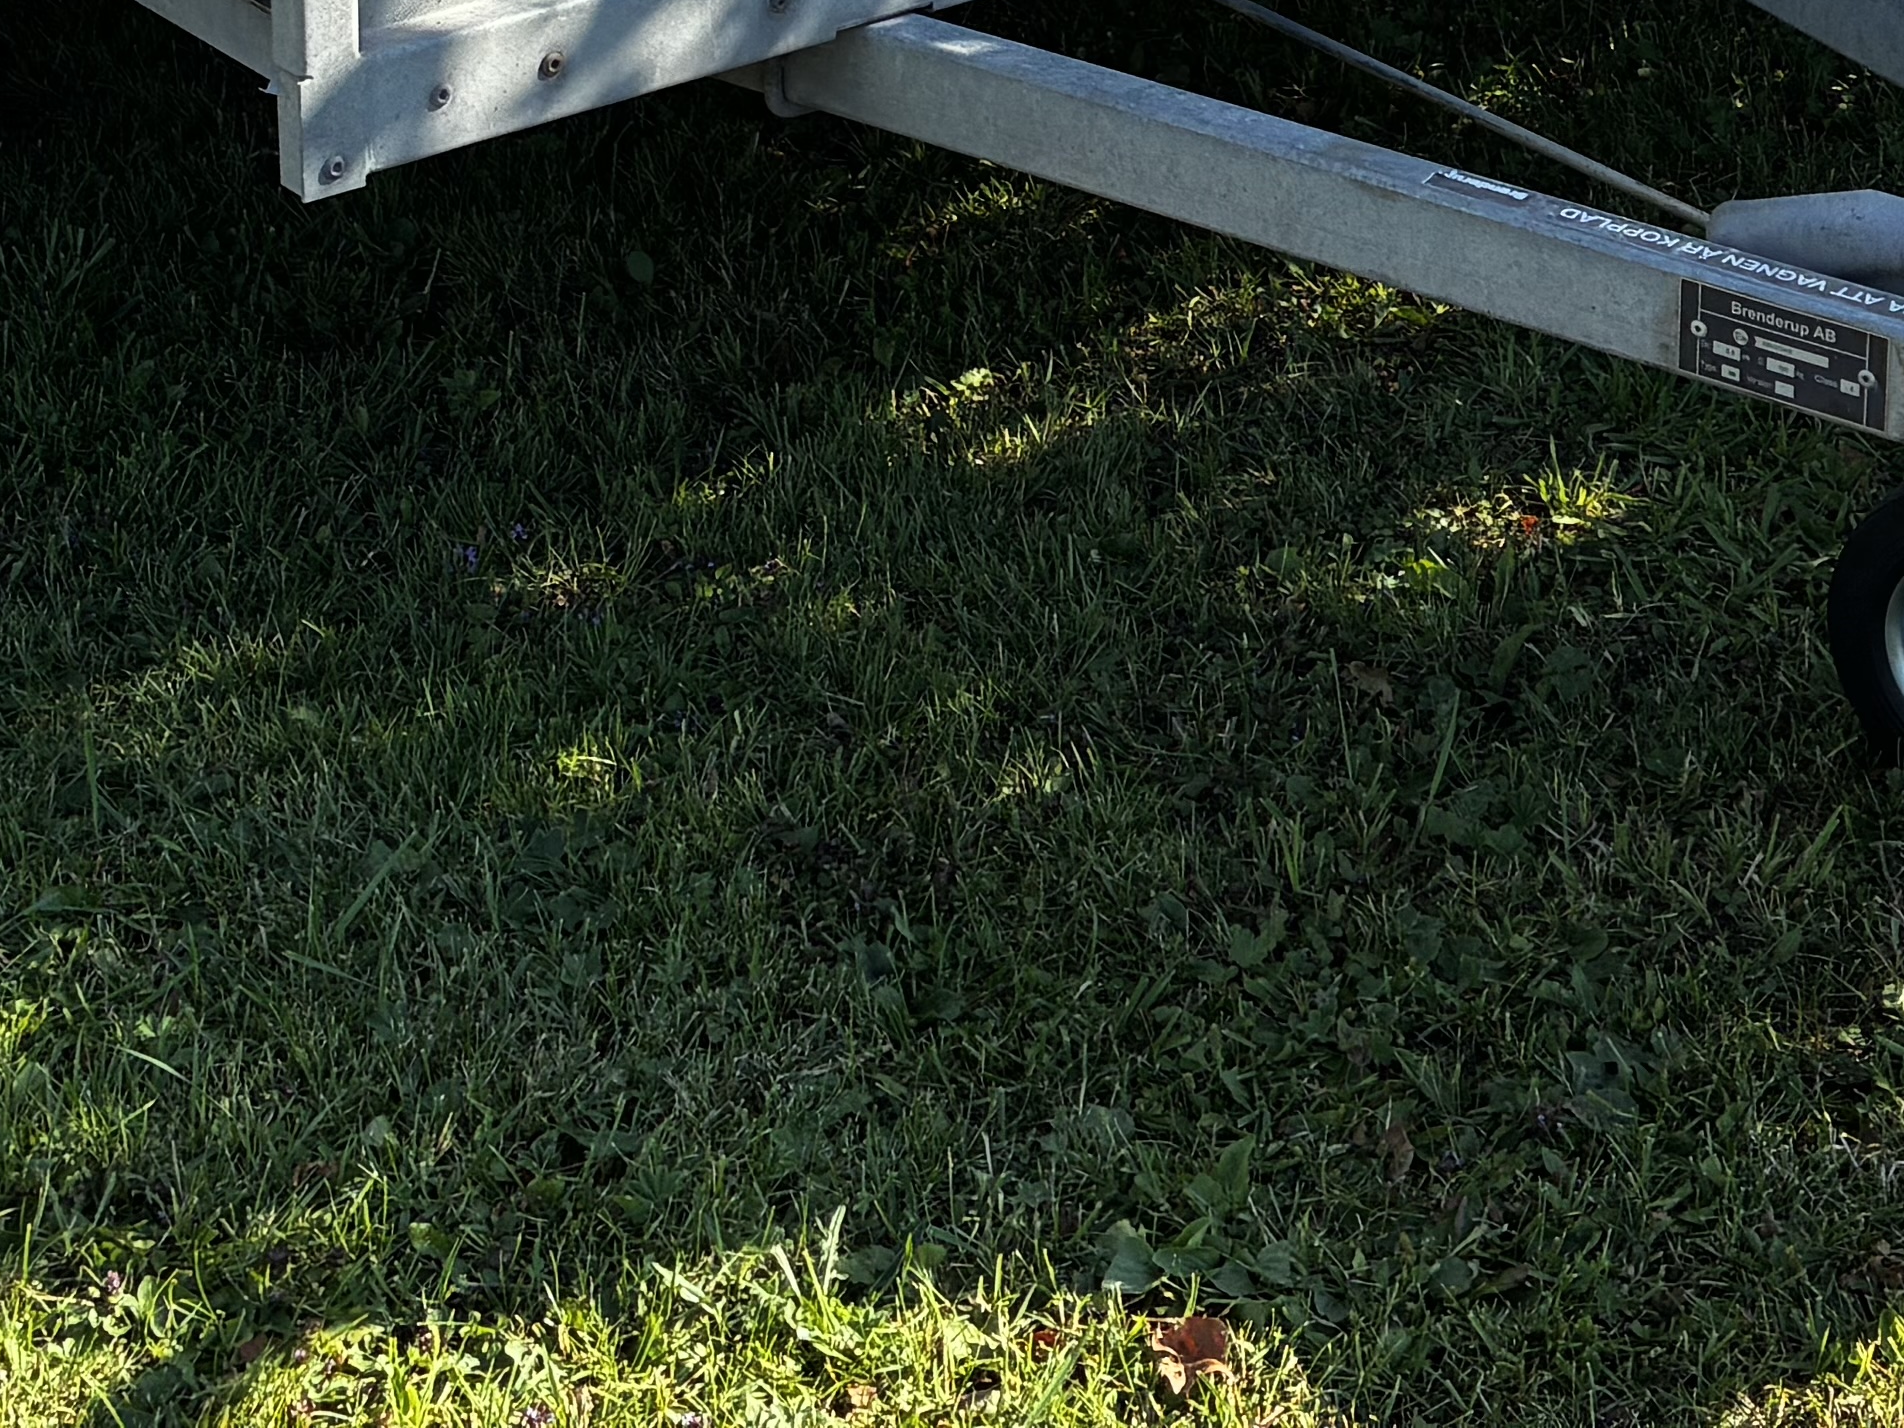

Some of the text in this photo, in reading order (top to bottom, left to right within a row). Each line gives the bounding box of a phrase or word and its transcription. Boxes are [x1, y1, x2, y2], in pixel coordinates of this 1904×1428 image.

[1559, 207, 1680, 247] KOPPLAD
[1721, 252, 1828, 292] VAGNEN
[1830, 283, 1881, 306] ATT
[1730, 300, 1837, 344] Brenderup AB
